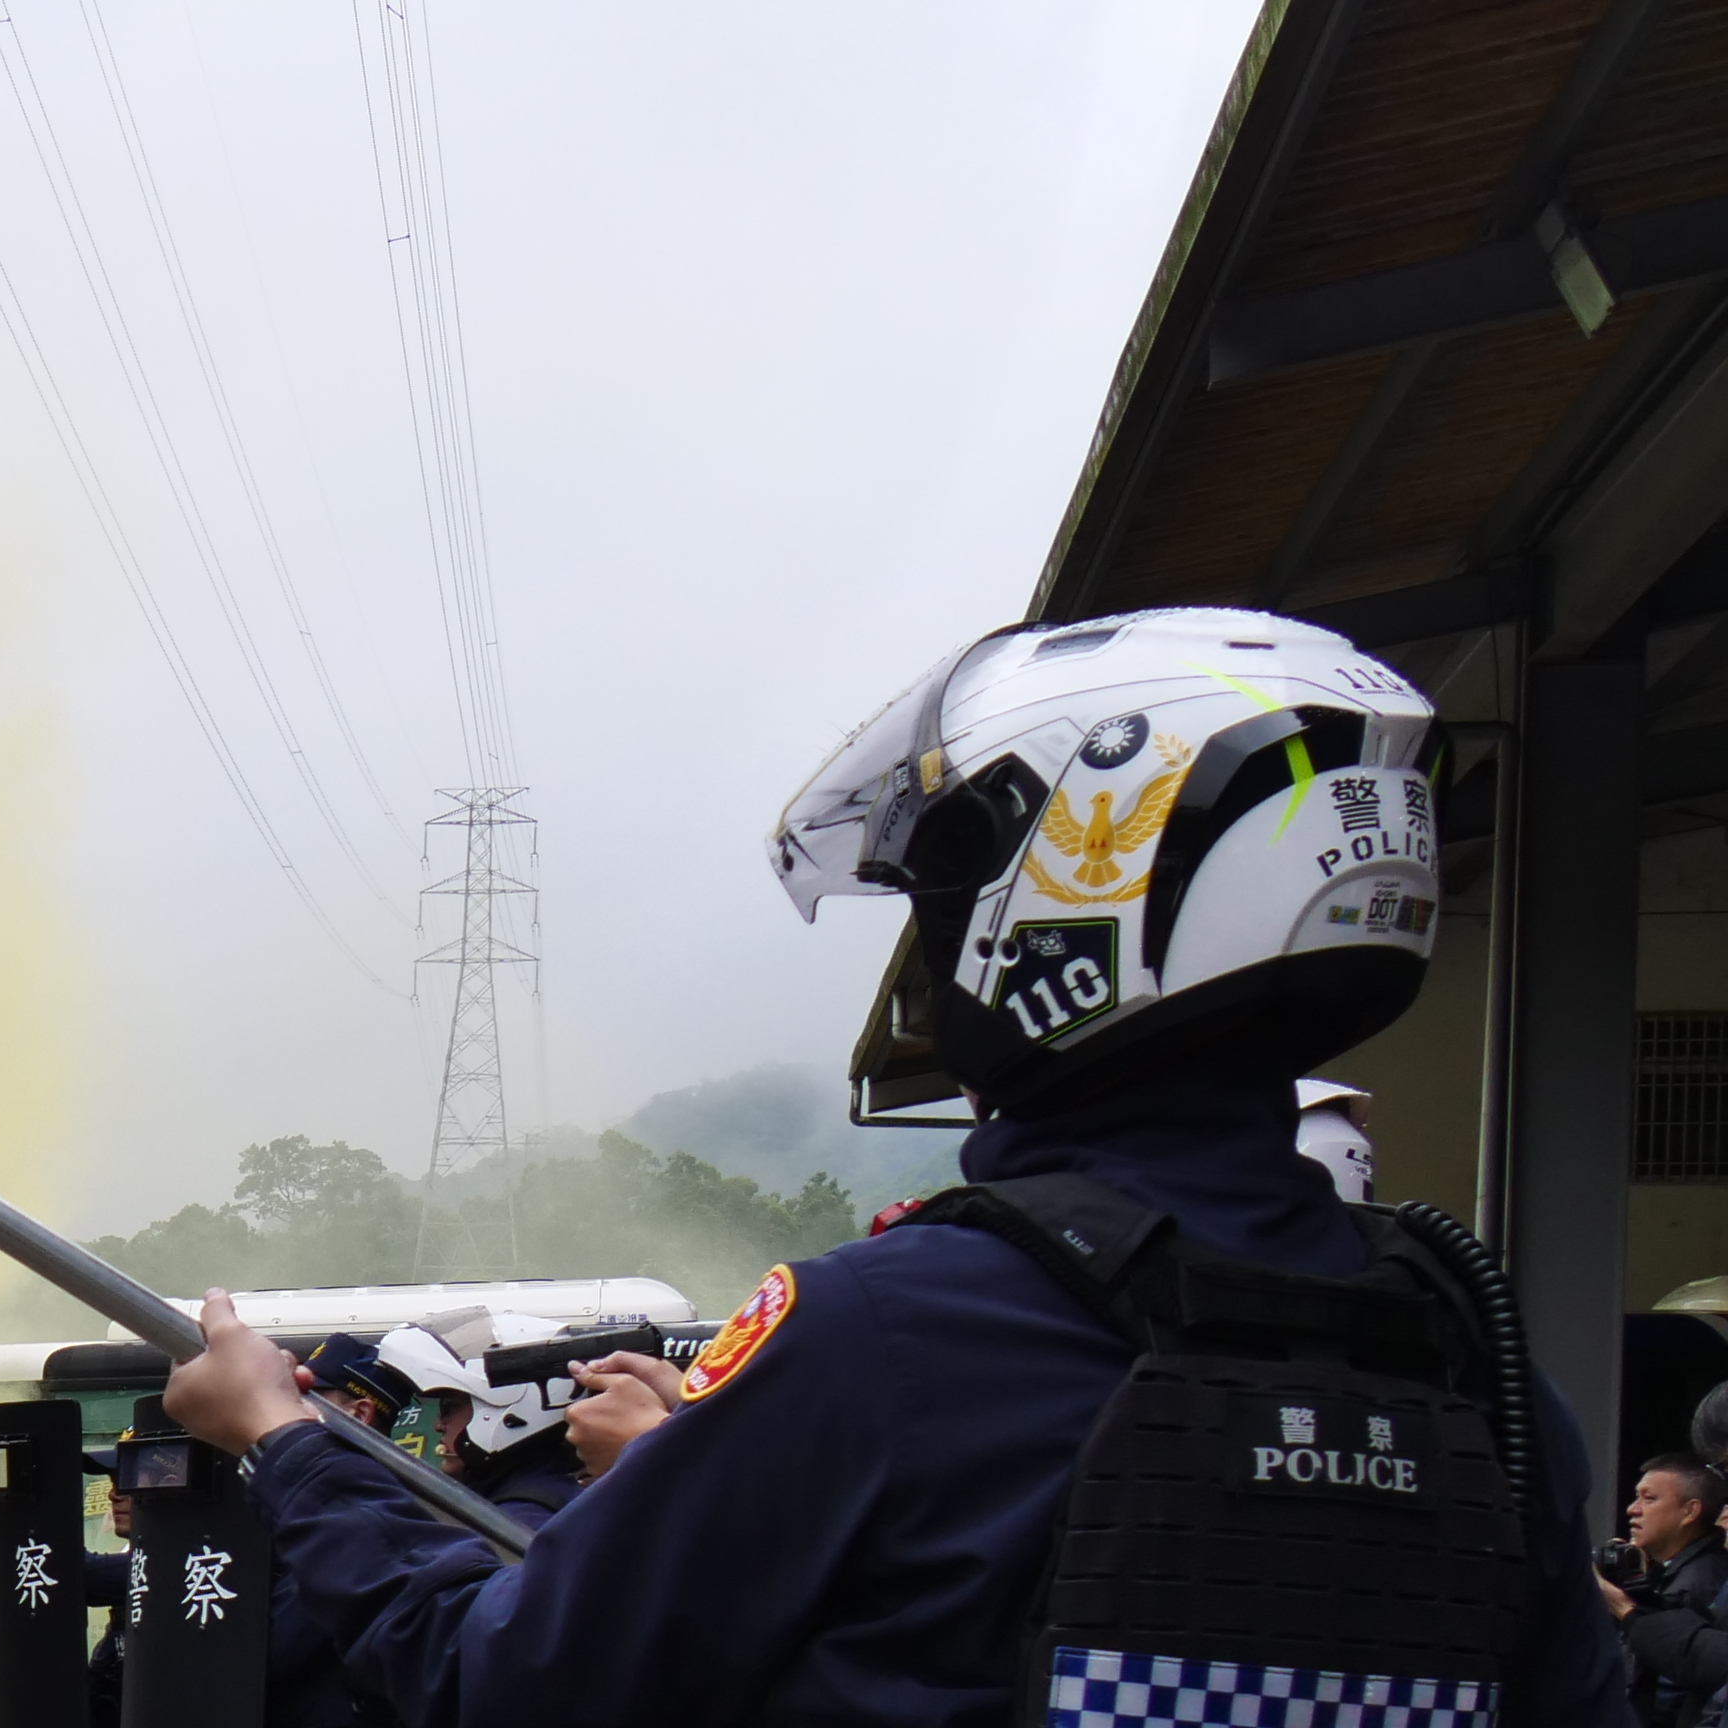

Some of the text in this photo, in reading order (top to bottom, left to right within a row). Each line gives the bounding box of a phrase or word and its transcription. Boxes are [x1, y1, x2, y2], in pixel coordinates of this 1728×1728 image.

[1329, 776, 1431, 835] 警察
[1369, 898, 1400, 919] DOT
[1006, 955, 1111, 1041] 110
[1279, 1406, 1394, 1452] 警察
[1252, 1447, 1419, 1493] POLICE
[129, 1545, 240, 1625] 警察
